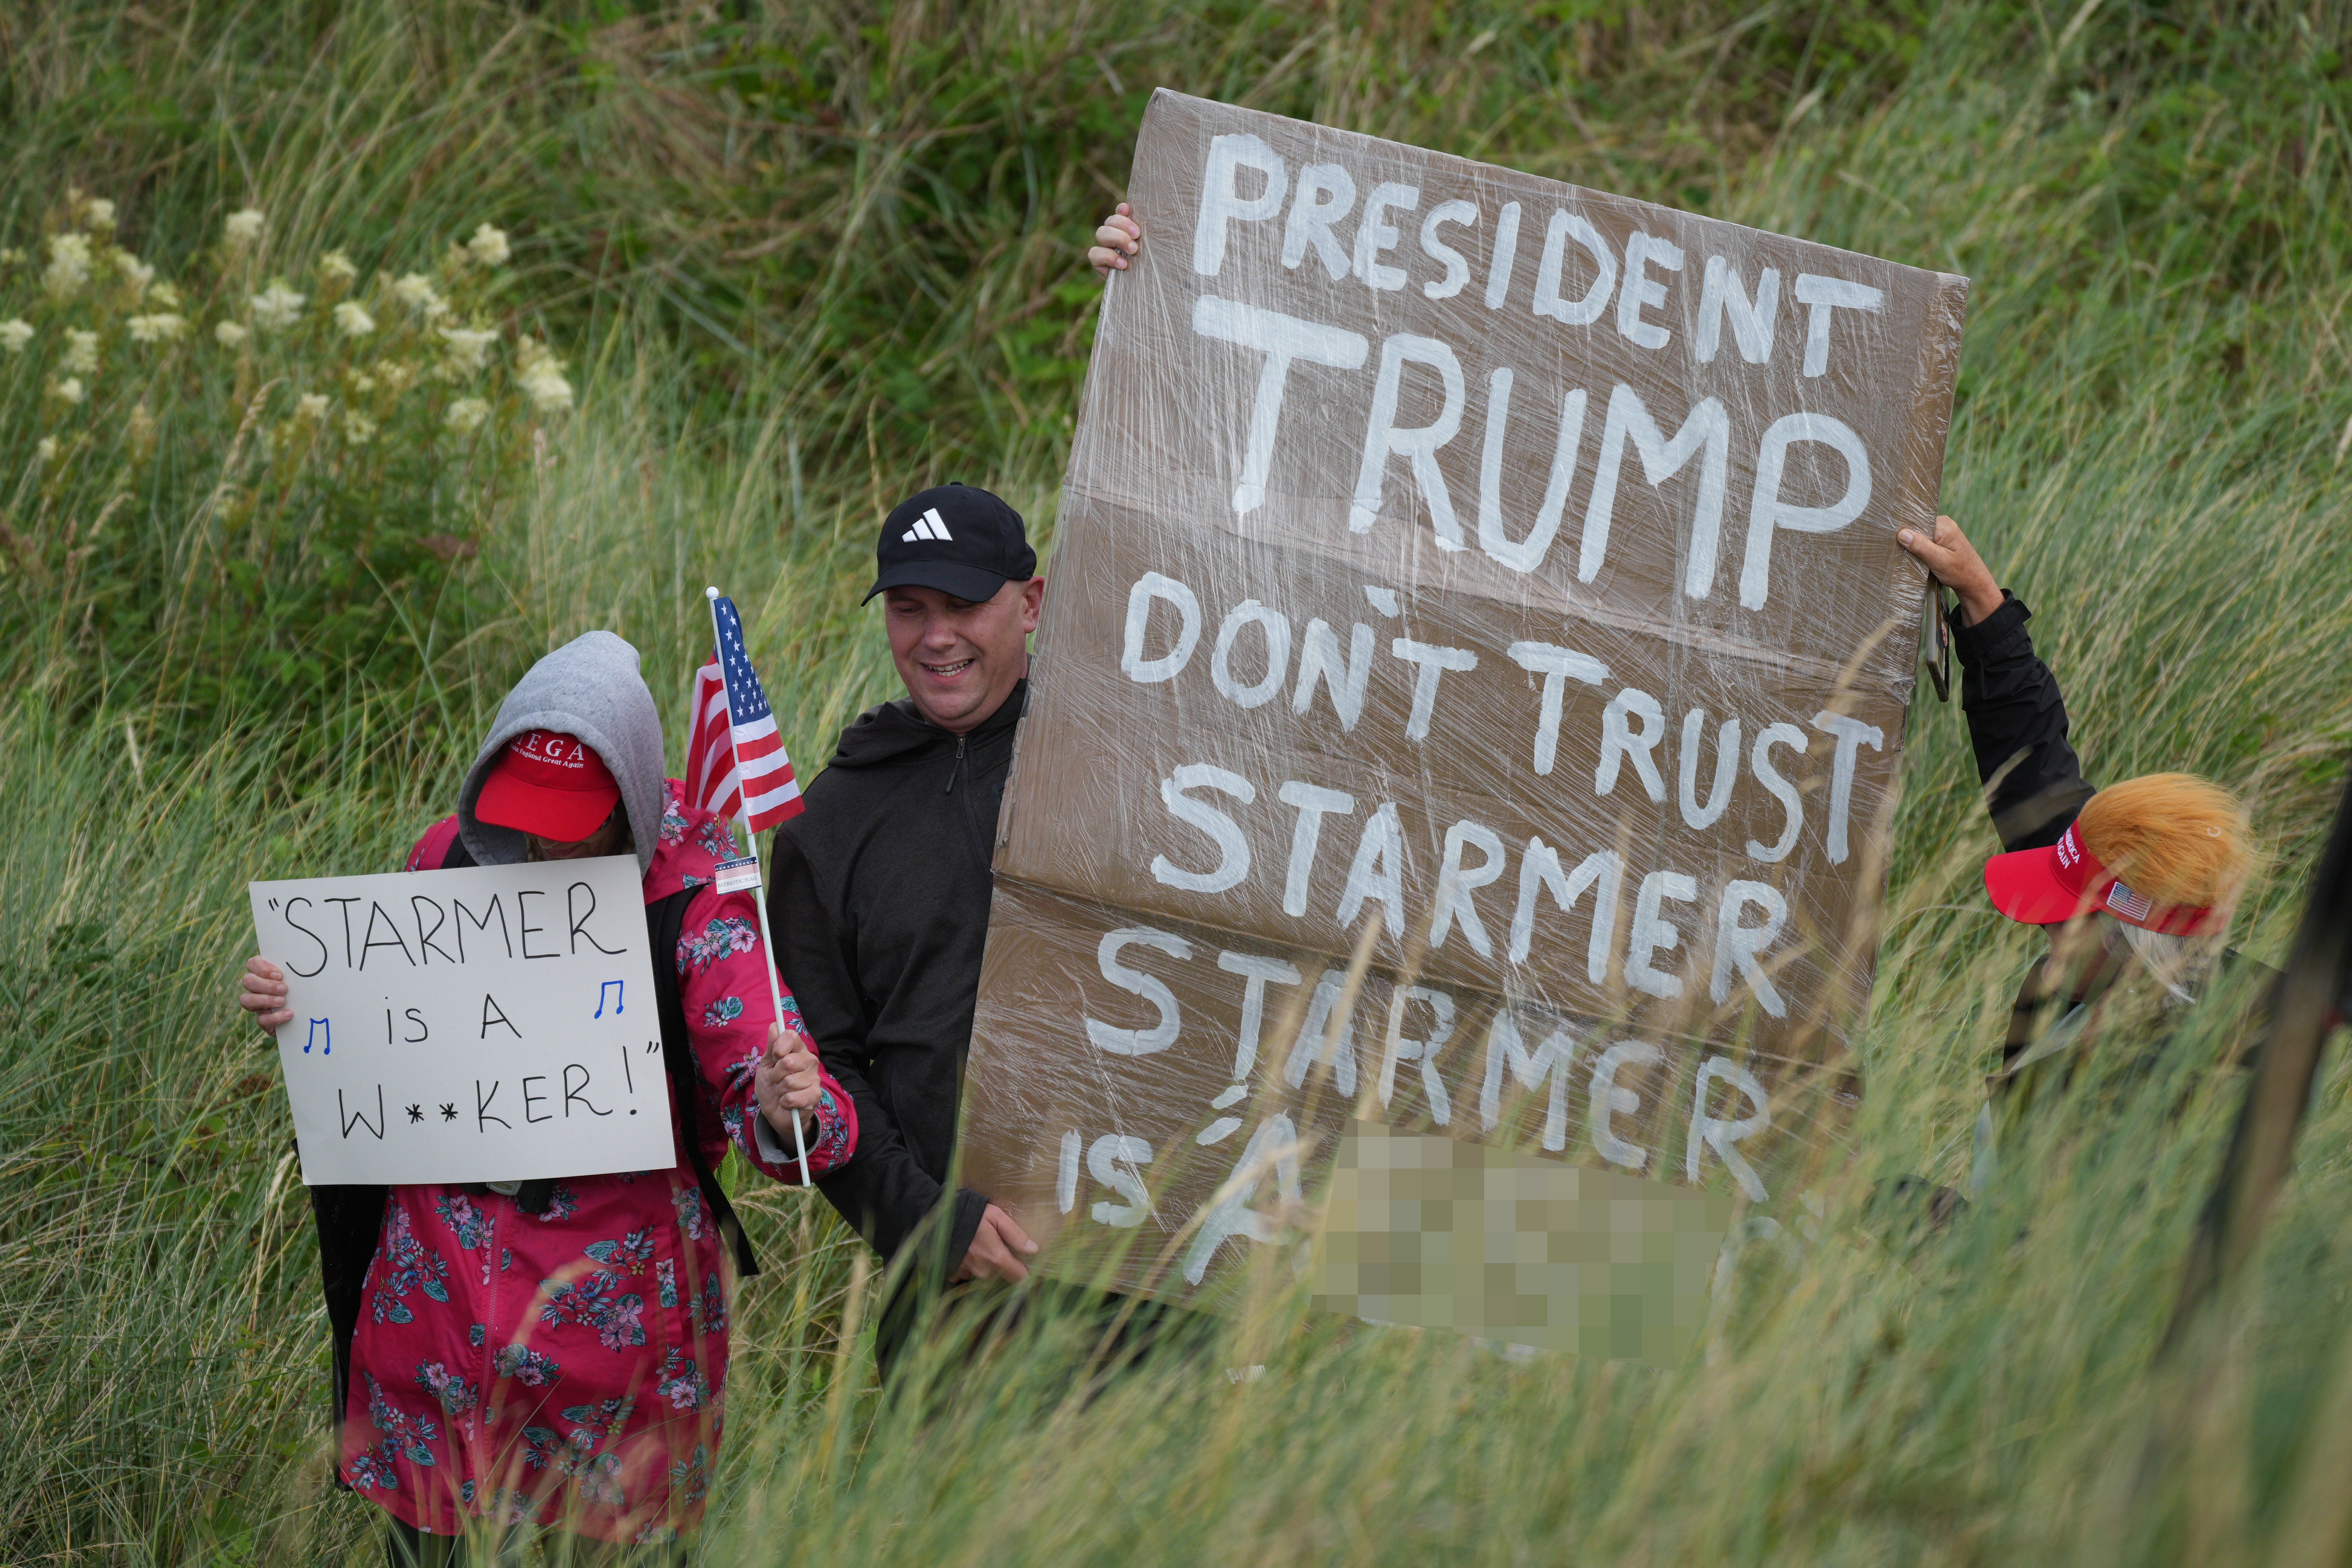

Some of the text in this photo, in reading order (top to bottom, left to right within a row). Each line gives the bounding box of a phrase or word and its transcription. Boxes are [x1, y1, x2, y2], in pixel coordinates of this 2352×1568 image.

[1193, 133, 1885, 378] PRESIDENT
[1192, 294, 1873, 612] TRUMP
[519, 748, 542, 761] England
[543, 756, 562, 765] Great
[1122, 570, 1884, 865] DON'T TRUST
[718, 878, 744, 888] PATRIOTIC
[1151, 763, 1788, 1018] STARMER
[385, 994, 522, 1044] is A
[1086, 925, 1771, 1202] STARMER
[1058, 1127, 1155, 1228] IS
